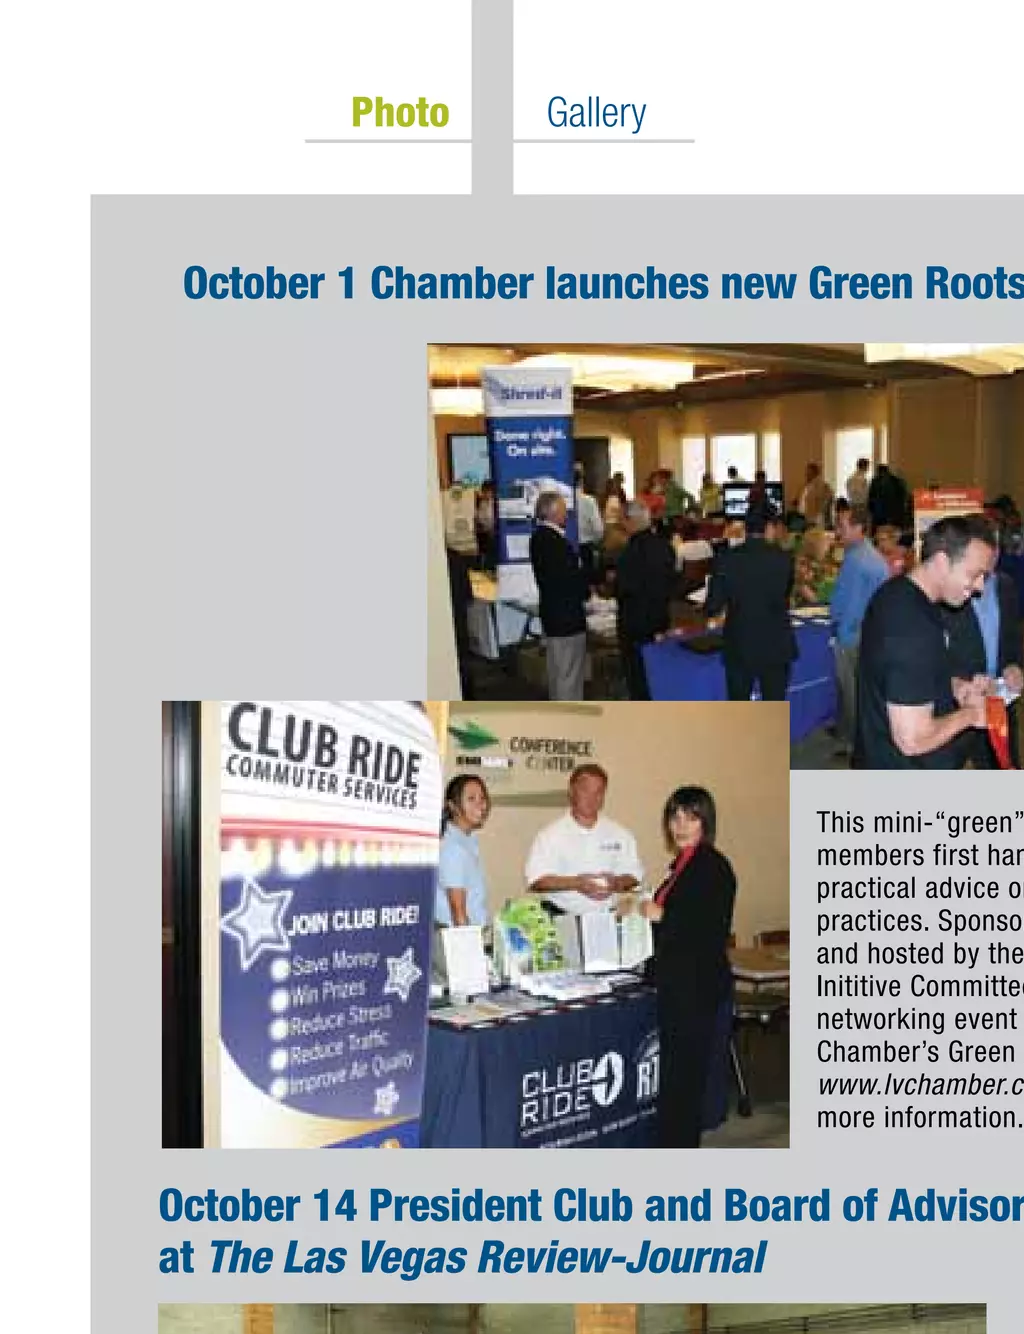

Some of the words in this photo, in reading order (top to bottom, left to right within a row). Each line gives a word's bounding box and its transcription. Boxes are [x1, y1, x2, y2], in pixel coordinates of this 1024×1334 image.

[352, 96, 449, 127] Photo
[548, 96, 646, 134] Gallery
[184, 265, 325, 299] October
[338, 266, 353, 299] 1
[371, 266, 534, 299] Chamber
[547, 266, 709, 299] launches
[722, 273, 797, 299] new
[810, 266, 912, 299] Green
[228, 701, 338, 768] CLUB
[349, 734, 422, 789] RIDE
[225, 754, 338, 794] COMMUTER
[342, 776, 417, 810] SERVICES
[817, 811, 864, 833] This
[818, 844, 924, 866] members
[933, 844, 979, 866] first
[288, 913, 328, 936] JOIN
[332, 908, 375, 931] CLUB
[818, 909, 928, 936] practices.
[292, 956, 330, 976] Save
[332, 948, 381, 969] Money
[291, 984, 319, 1008] Win
[322, 978, 367, 1002] Prizes
[818, 975, 900, 997] Inititive
[290, 1013, 345, 1036] Reduce
[290, 1041, 344, 1064] Reduce
[522, 1058, 594, 1098] CLUB
[520, 1086, 591, 1127] RIDE
[818, 1111, 874, 1128] more
[885, 1106, 1022, 1128] information.
[160, 1188, 301, 1222] October
[314, 1189, 357, 1221] 14
[370, 1188, 542, 1222] President
[554, 1188, 632, 1222] Club
[645, 1188, 711, 1222] and
[725, 1188, 830, 1222] Board
[843, 1188, 878, 1222] of
[159, 1241, 194, 1273] at
[211, 1240, 273, 1273] The
[284, 1240, 347, 1273] Las
[362, 1240, 467, 1281] Vegas
[478, 1240, 768, 1274] Review-Journal
